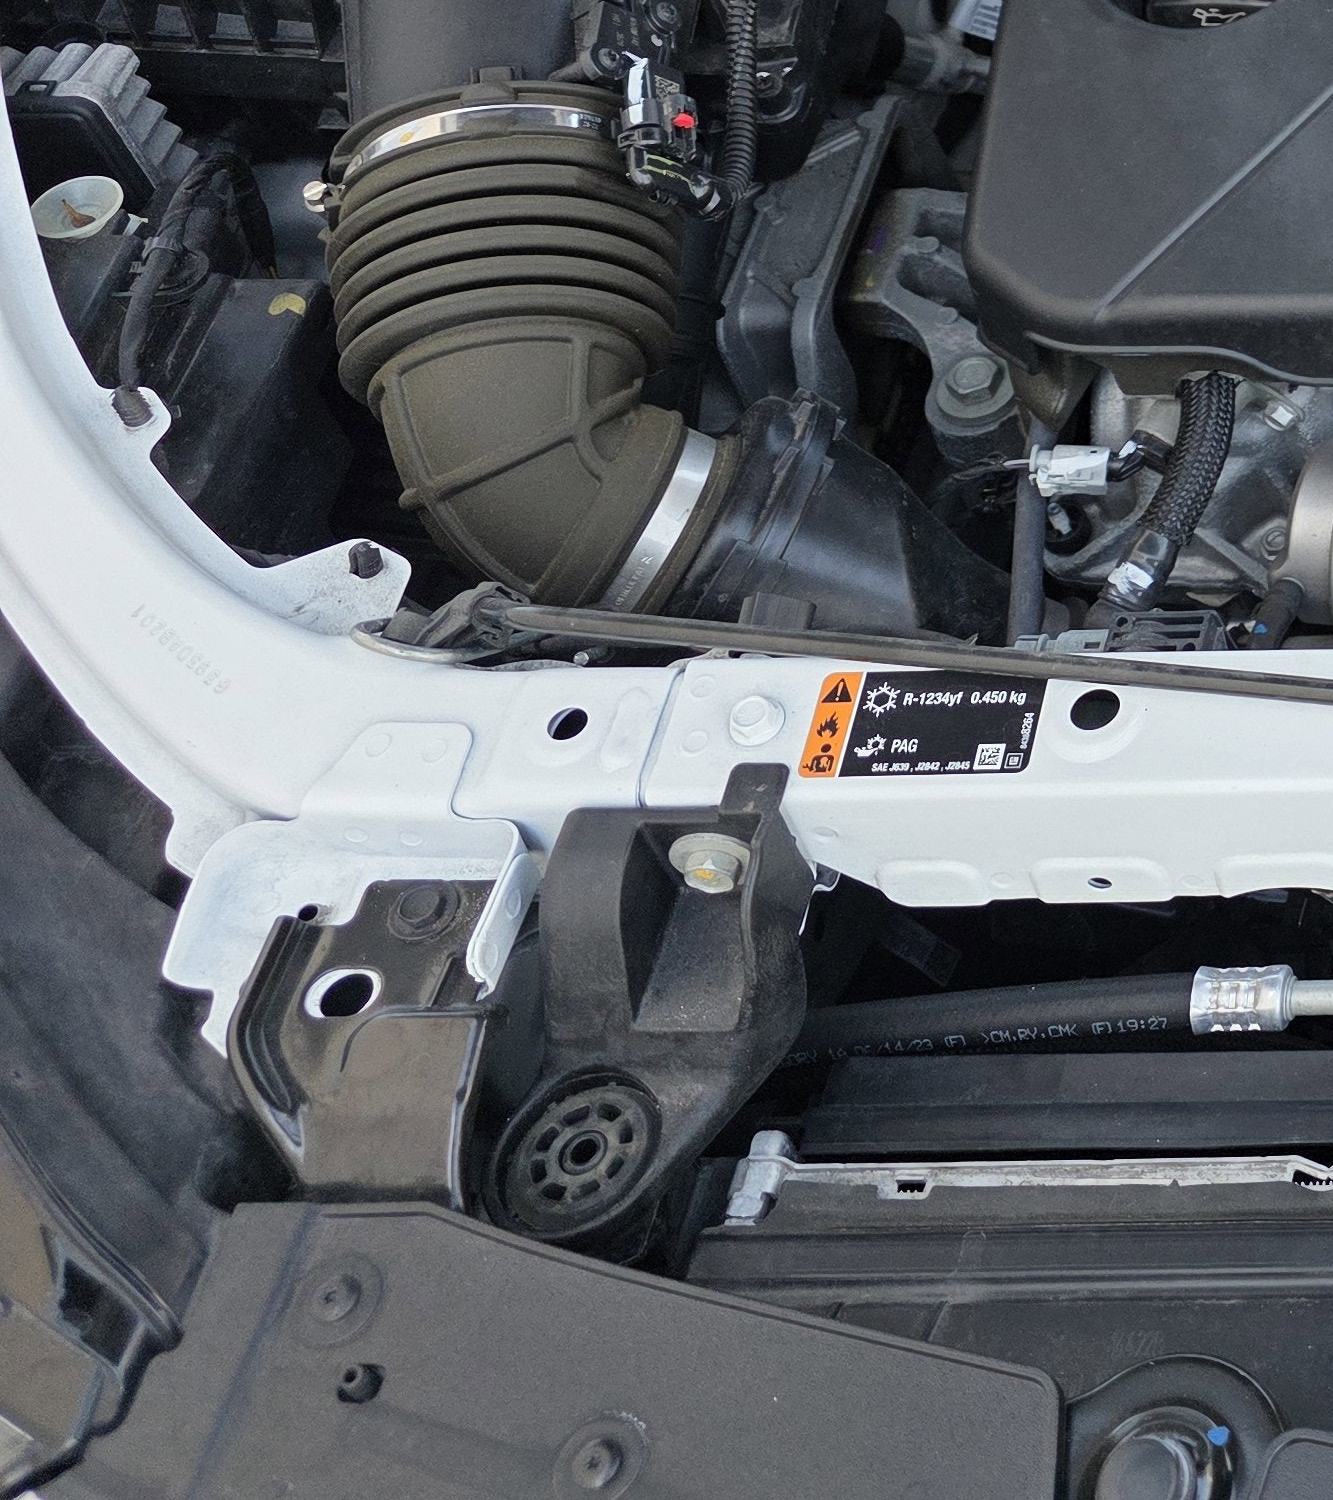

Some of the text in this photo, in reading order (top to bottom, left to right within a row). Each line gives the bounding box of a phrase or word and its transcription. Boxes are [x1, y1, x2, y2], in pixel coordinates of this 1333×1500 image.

[902, 690, 1027, 708] R-1234yf 0.450 kg
[890, 738, 919, 754] PAG
[871, 762, 889, 773] SAE
[944, 760, 971, 771] J2845
